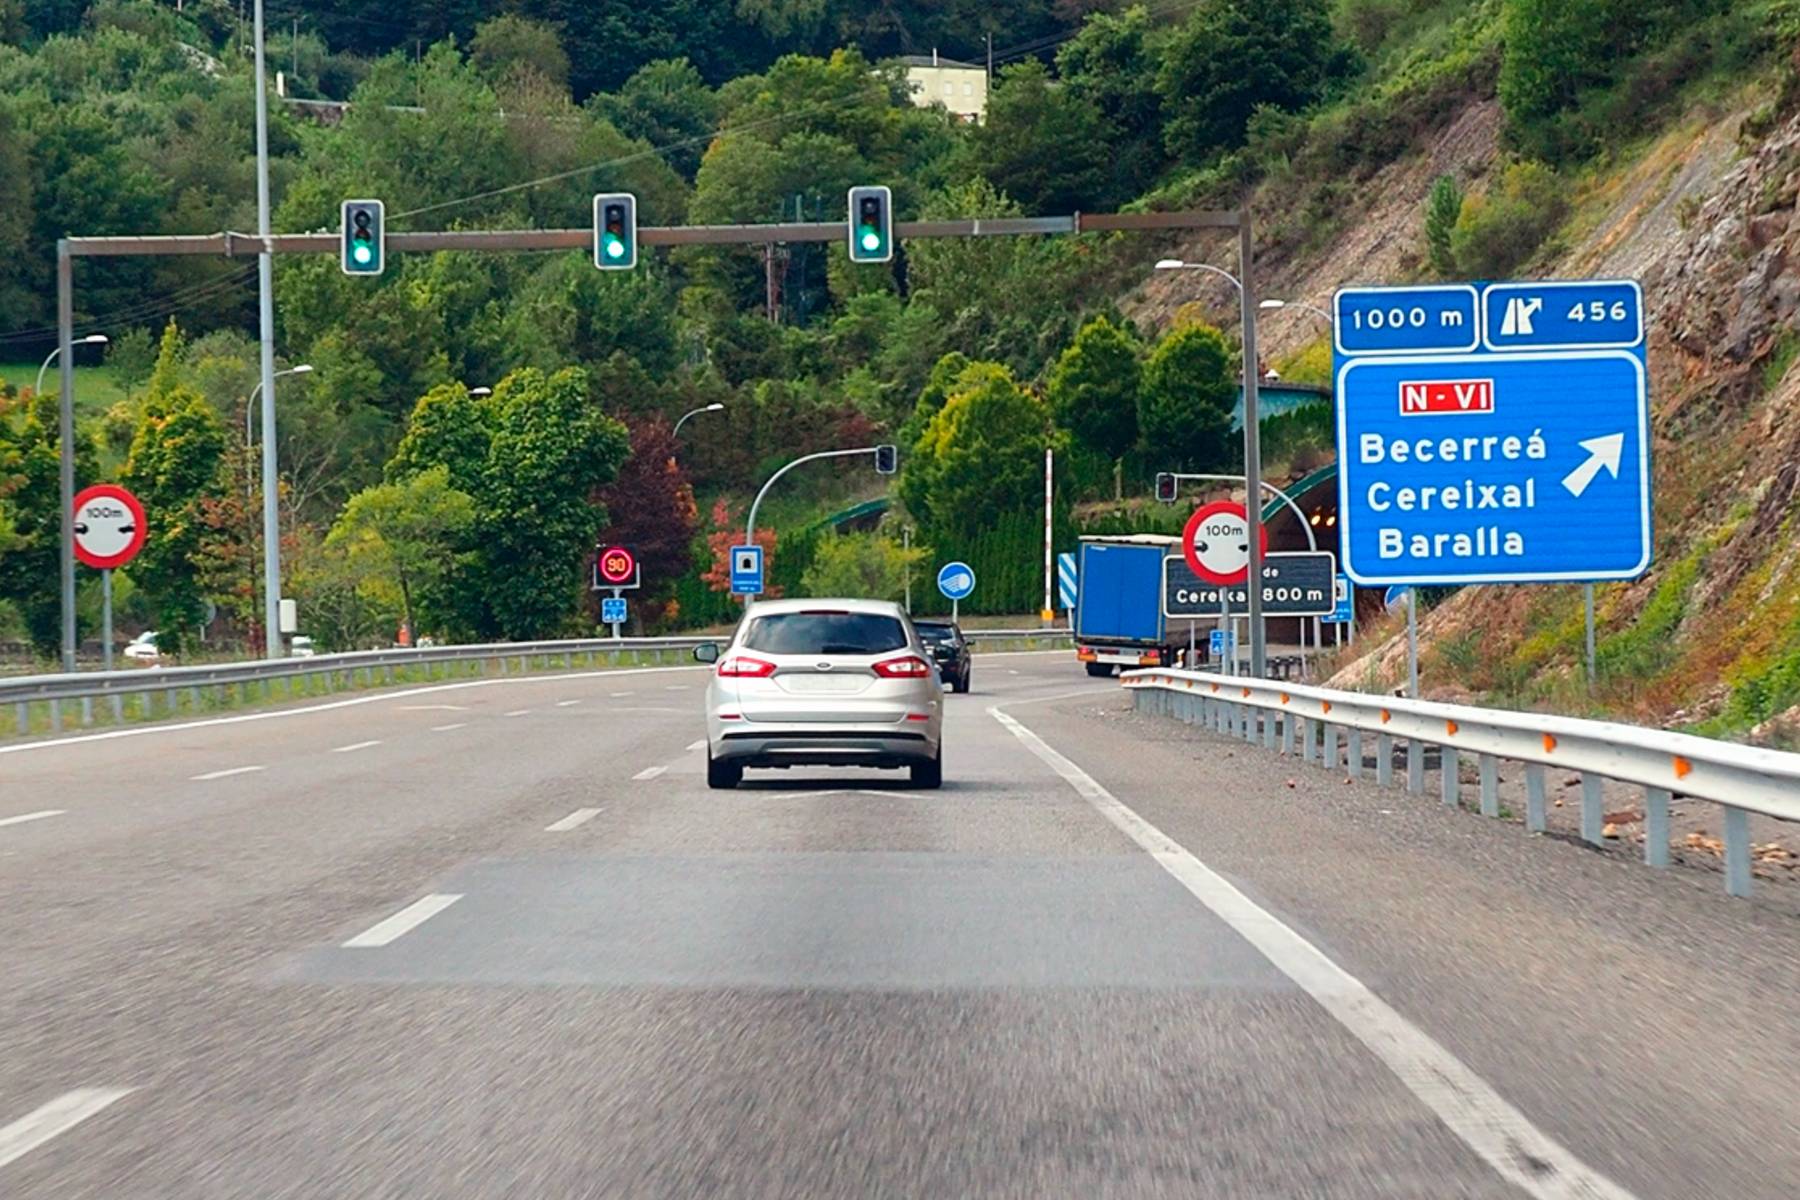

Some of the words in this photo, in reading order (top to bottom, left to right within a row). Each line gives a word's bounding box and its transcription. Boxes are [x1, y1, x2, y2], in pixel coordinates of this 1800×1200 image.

[1352, 307, 1426, 330] 1000
[1440, 309, 1463, 327] m
[1567, 301, 1627, 322] 456
[1360, 428, 1546, 464] Becerreá
[1367, 478, 1535, 512] Cereixal
[86, 507, 123, 518] 100m
[1206, 524, 1243, 537] 100m
[1378, 526, 1525, 559] Baralla
[607, 557, 626, 572] 90
[1262, 567, 1279, 578] de
[1262, 587, 1302, 602] 800
[1307, 589, 1323, 601] m
